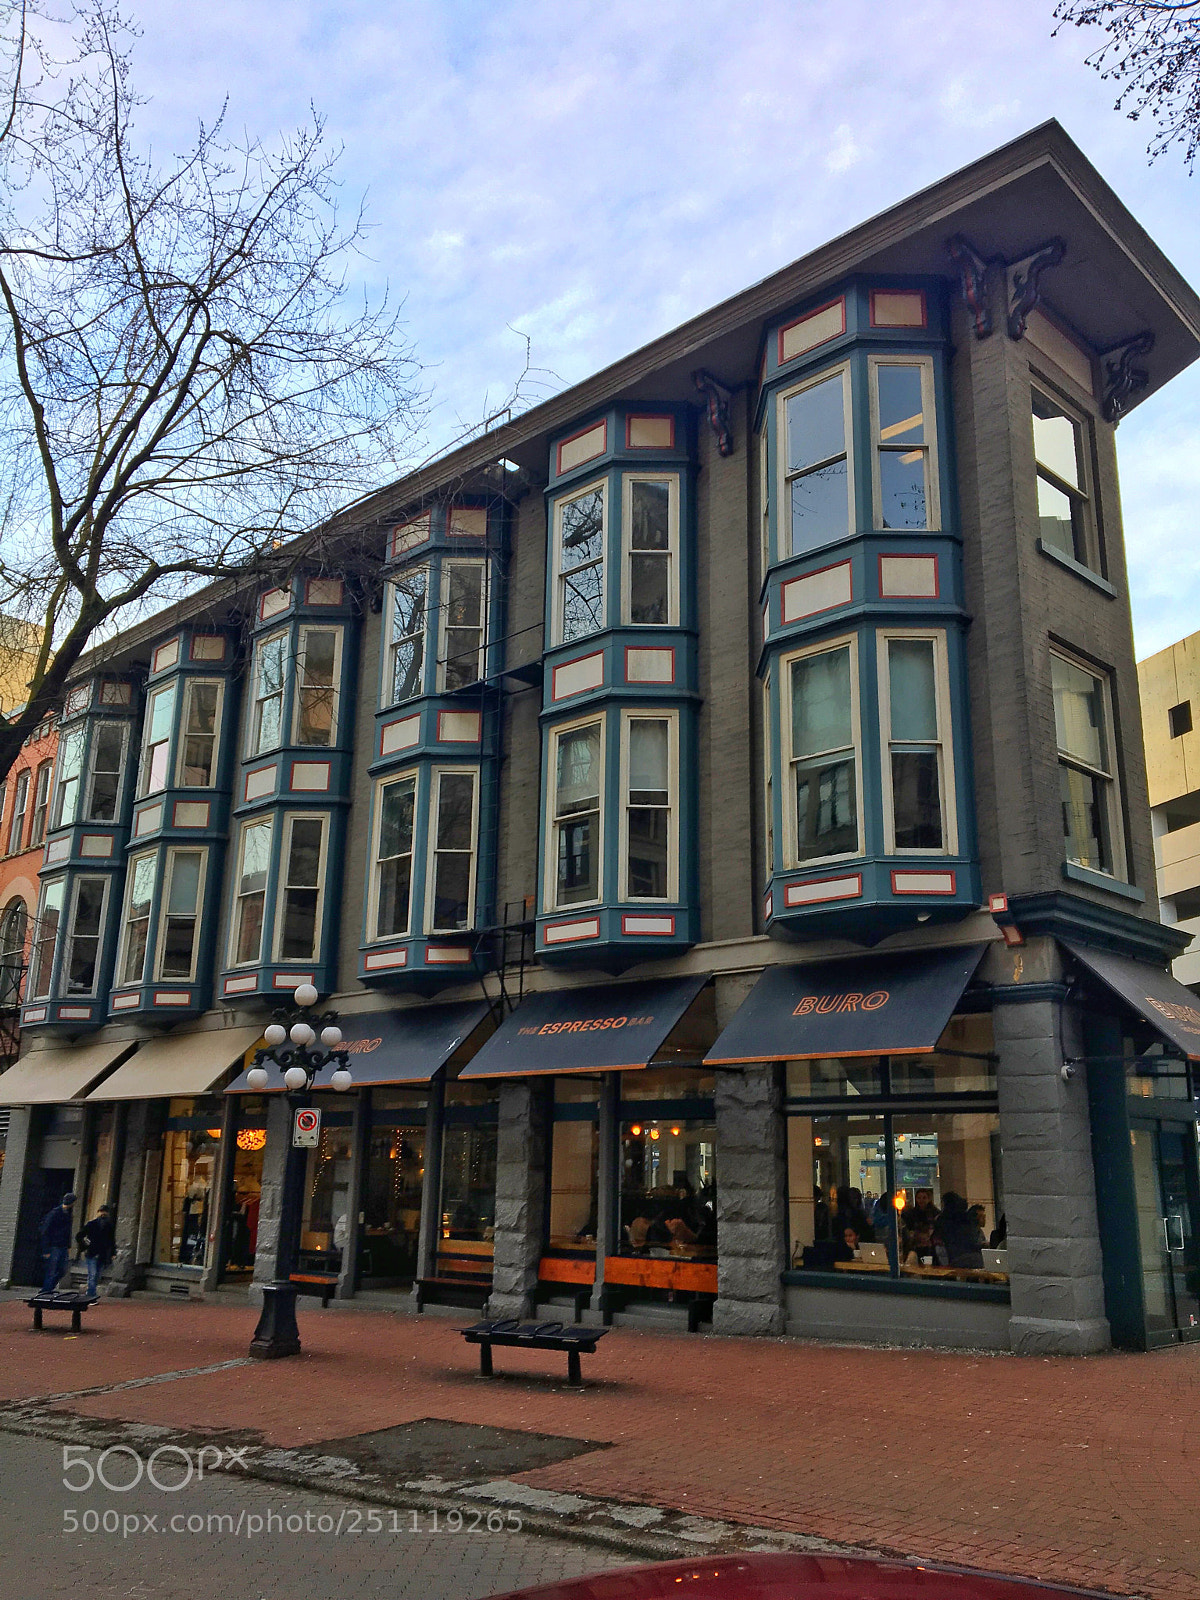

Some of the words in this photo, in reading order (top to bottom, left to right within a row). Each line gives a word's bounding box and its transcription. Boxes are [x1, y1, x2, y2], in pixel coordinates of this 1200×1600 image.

[792, 990, 890, 1016] BURO
[517, 1026, 540, 1036] THE
[537, 1016, 628, 1036] ESPRESSO
[626, 1015, 655, 1027] BAR
